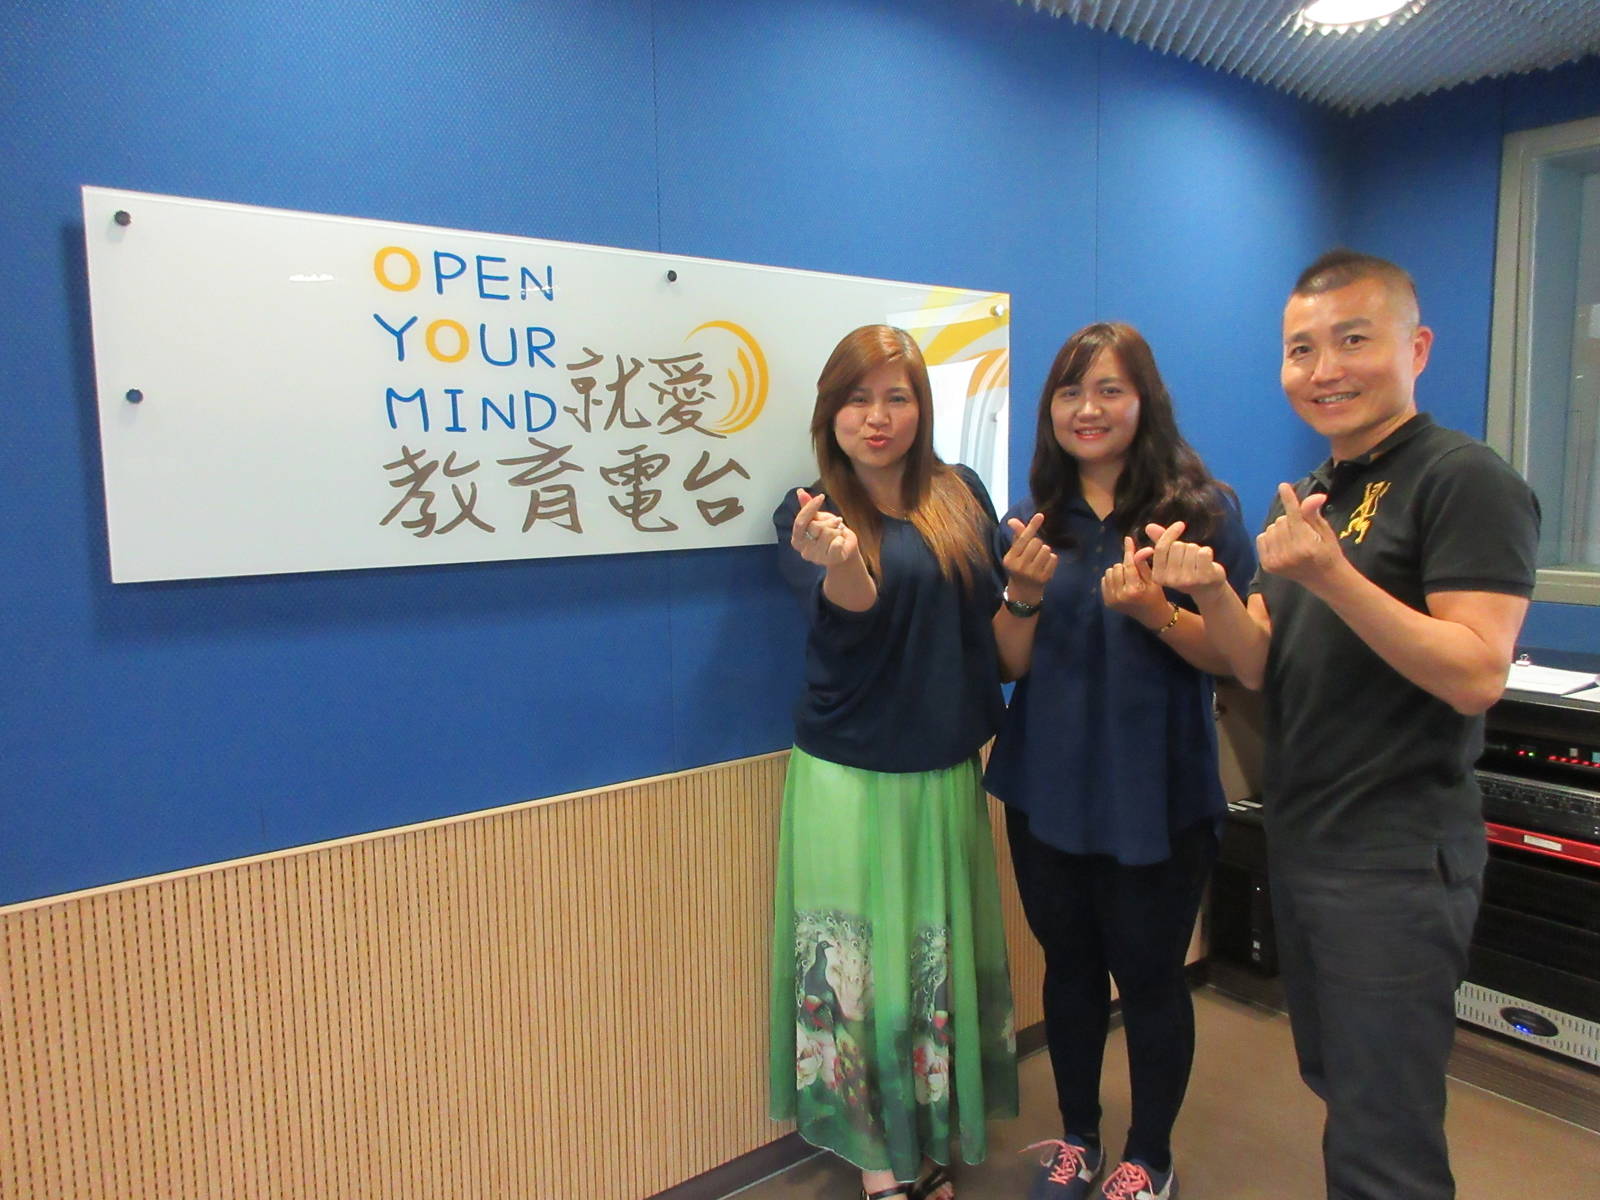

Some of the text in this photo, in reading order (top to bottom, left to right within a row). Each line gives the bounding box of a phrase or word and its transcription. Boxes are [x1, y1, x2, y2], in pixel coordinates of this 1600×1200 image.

[373, 246, 554, 300] OPEN
[373, 313, 556, 368] YOUR
[385, 387, 557, 432] MIND
[563, 347, 727, 439] 就愛
[379, 437, 751, 538] 教育電台
